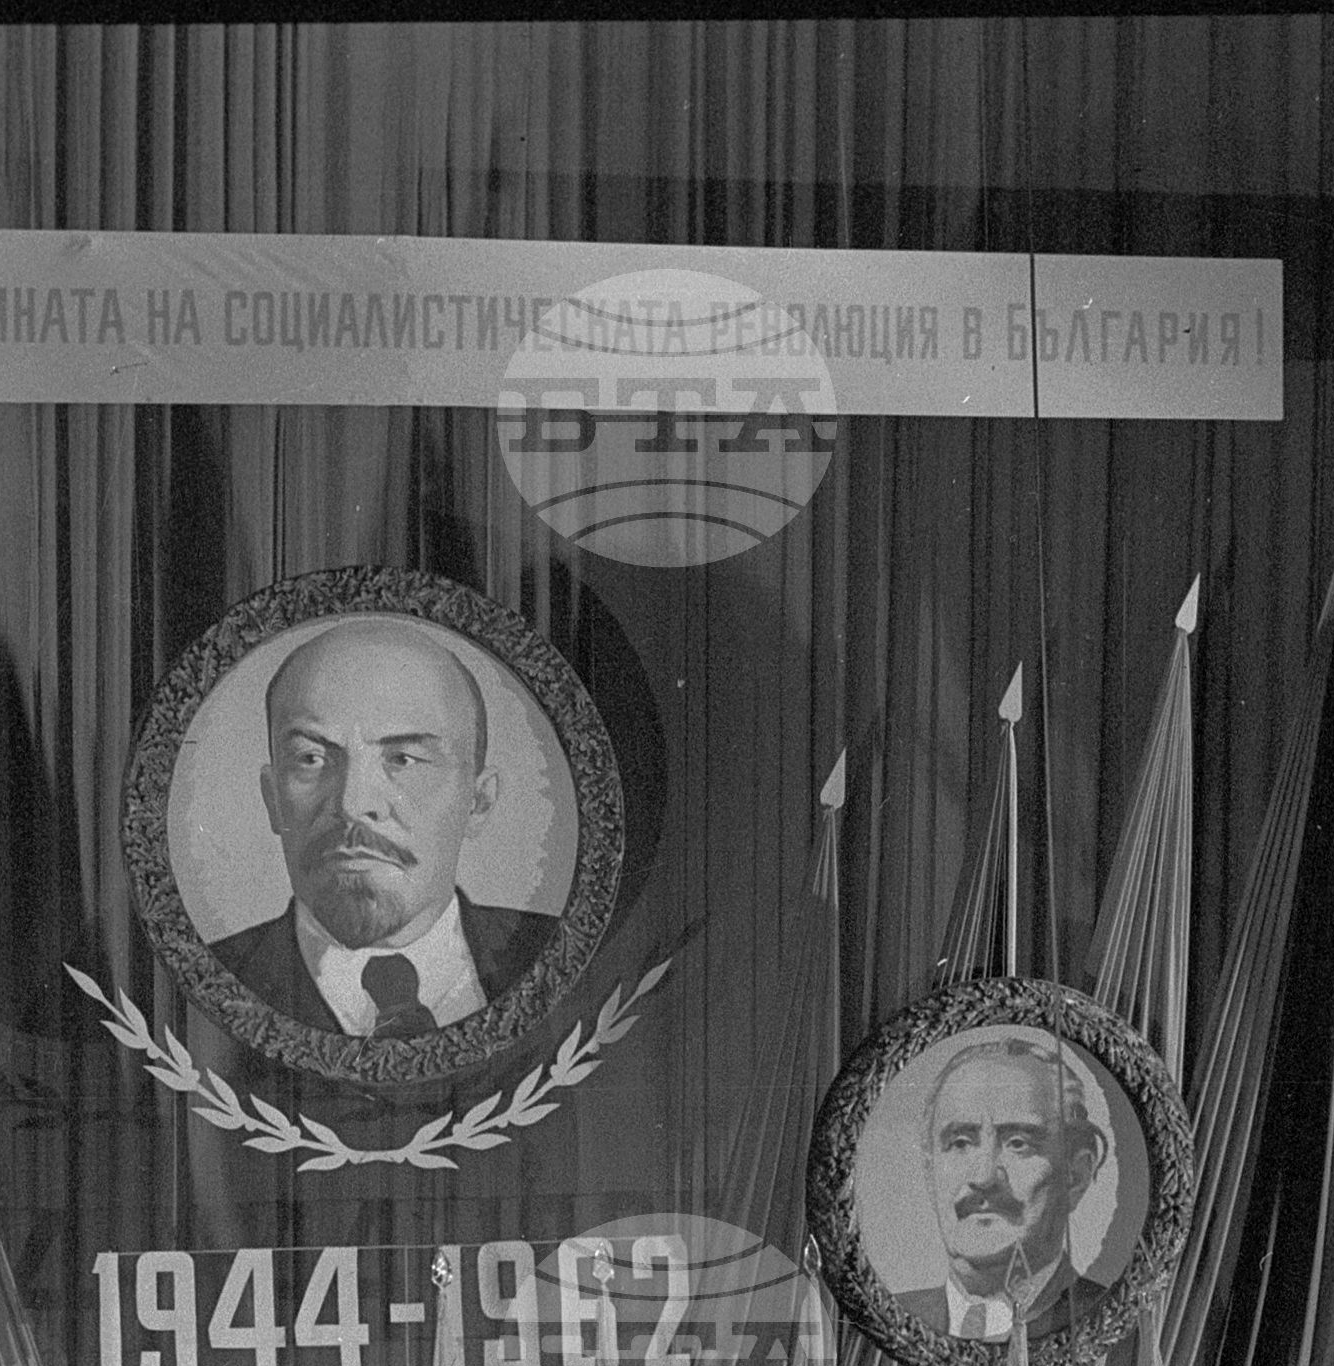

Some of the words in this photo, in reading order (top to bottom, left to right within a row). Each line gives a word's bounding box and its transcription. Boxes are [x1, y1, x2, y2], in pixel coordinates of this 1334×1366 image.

[147, 288, 202, 347] НА
[223, 289, 679, 356] СОЦИАЛИСТИЧЕСКАТА
[708, 302, 939, 366] РЕВОЛЮЦИЯ
[962, 307, 984, 360] В
